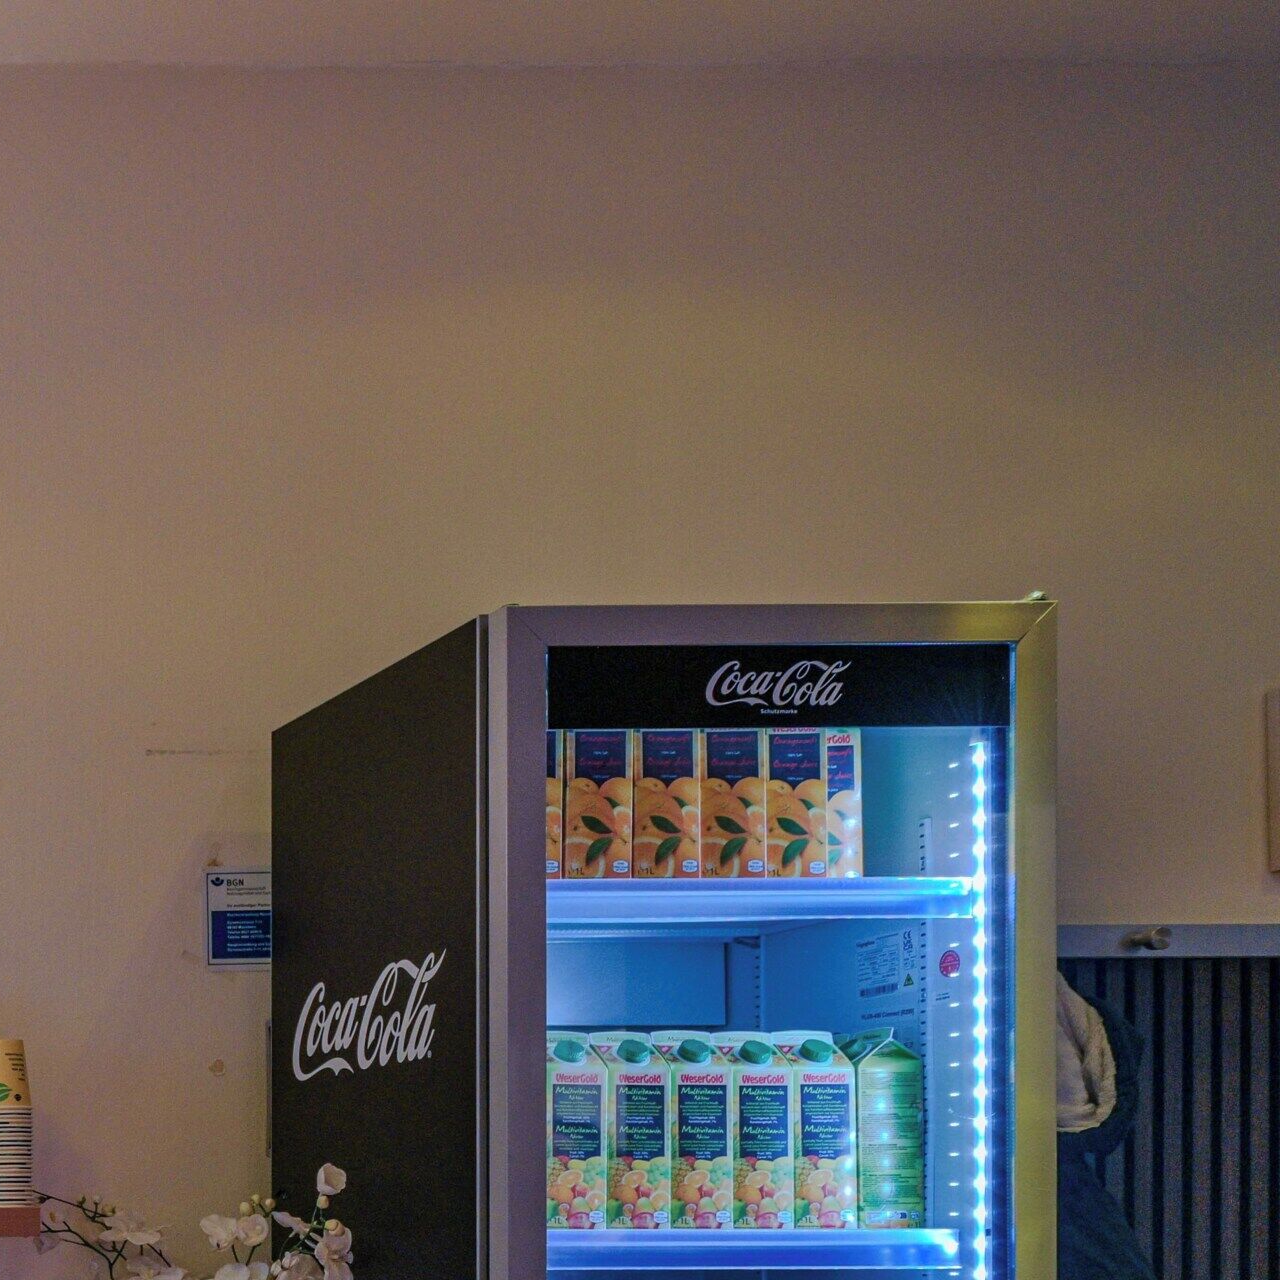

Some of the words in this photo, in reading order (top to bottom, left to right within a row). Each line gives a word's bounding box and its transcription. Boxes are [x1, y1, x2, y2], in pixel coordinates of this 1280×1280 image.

[705, 660, 852, 706] Coca-Cola
[226, 879, 244, 887] BGN
[293, 948, 446, 1081] Coca-Cola
[556, 1074, 598, 1083] WeserGold
[619, 1074, 661, 1084] WeserGold
[681, 1074, 723, 1084] WeserGold
[742, 1075, 784, 1084] WeserGold
[803, 1074, 845, 1083] WeserGold
[555, 1087, 598, 1095] Multivitamin
[619, 1087, 661, 1095] Multivitamin
[681, 1087, 723, 1095] Multivitamin
[556, 1125, 598, 1133] Multivitamin
[620, 1126, 661, 1134] Multivitamin
[682, 1125, 724, 1134] Multivitamin
[804, 1125, 846, 1133] Multivitamin
